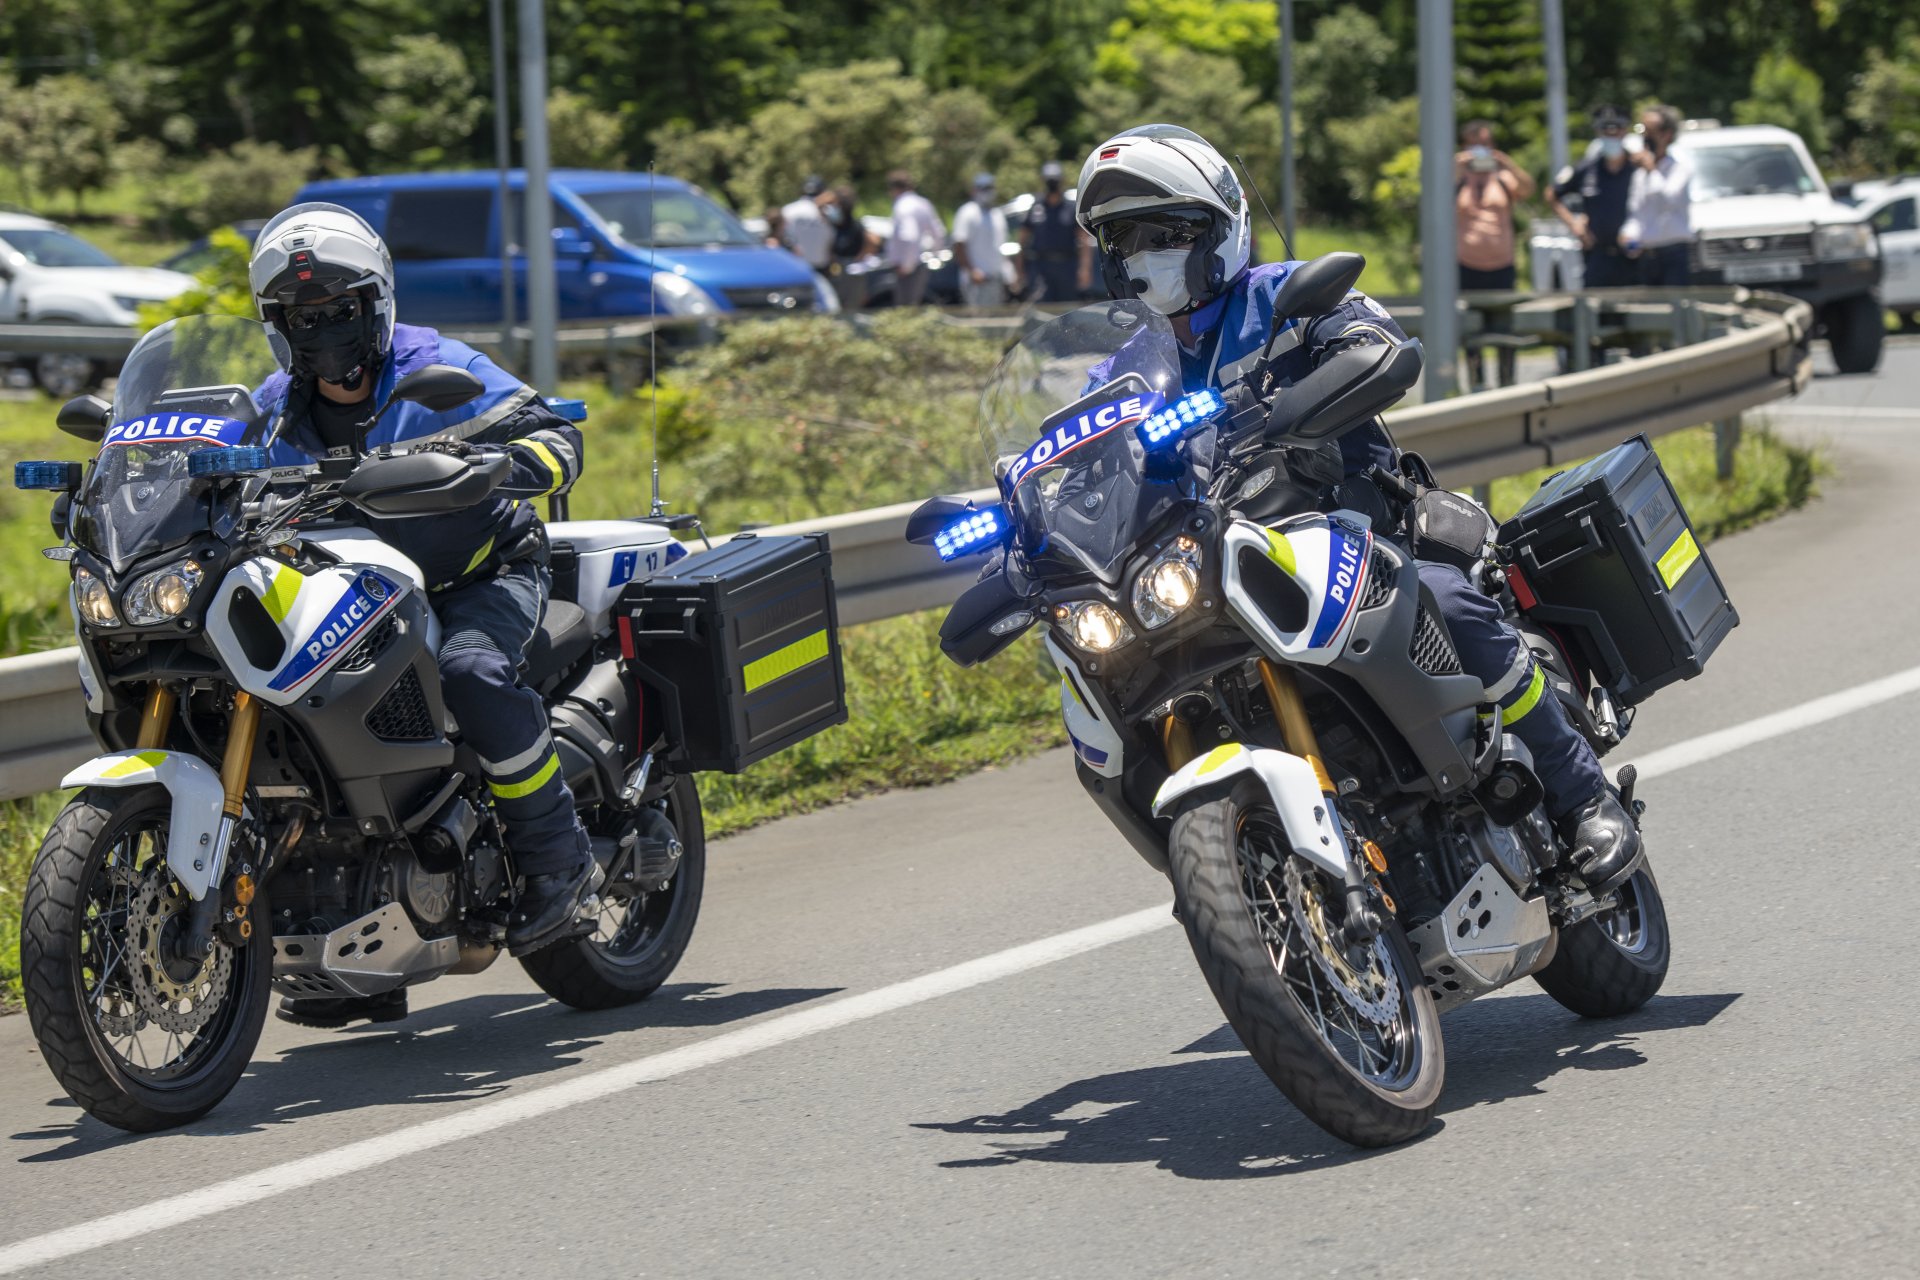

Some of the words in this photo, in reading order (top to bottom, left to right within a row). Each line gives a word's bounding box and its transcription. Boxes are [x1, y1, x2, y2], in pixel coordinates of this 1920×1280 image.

[103, 415, 225, 446] POLICE
[1010, 397, 1142, 486] POLICE
[645, 551, 658, 572] 17
[1330, 533, 1361, 605] POLICE
[306, 595, 372, 661] POLICE
